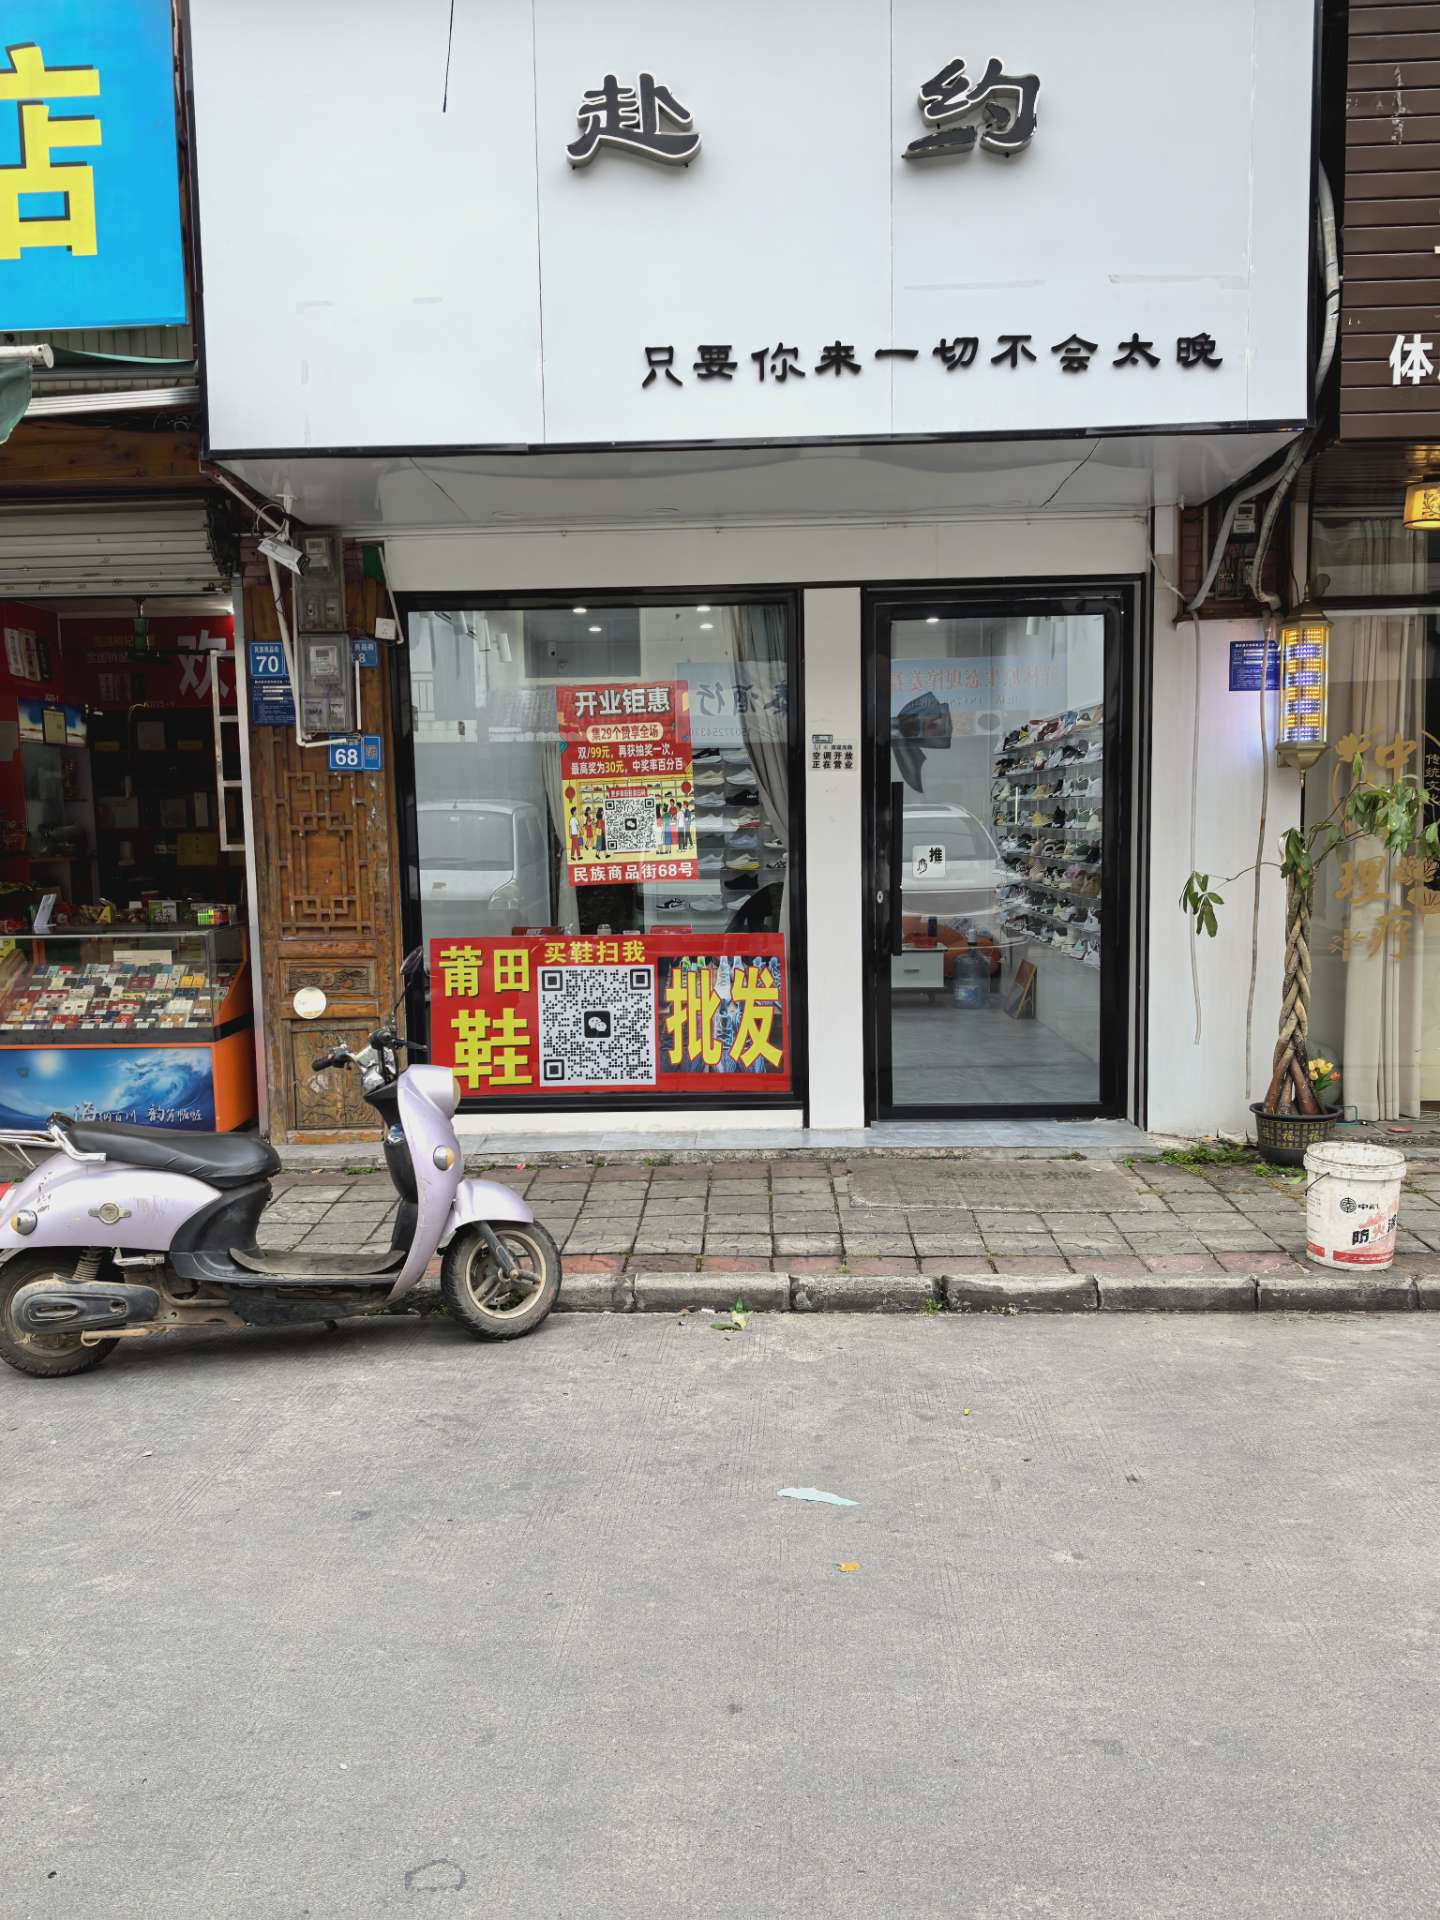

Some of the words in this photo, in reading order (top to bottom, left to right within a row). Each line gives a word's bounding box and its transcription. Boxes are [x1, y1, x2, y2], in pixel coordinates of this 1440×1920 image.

[641, 332, 1224, 388] 只要你来一切不会太晚
[256, 655, 279, 673] 70
[574, 687, 671, 719] 开业钜惠
[335, 748, 359, 765] 68
[928, 847, 943, 864] 推
[573, 861, 694, 882] 民族商品街68号
[544, 940, 646, 964] 买鞋扫我
[439, 945, 530, 998] 莆田
[664, 966, 784, 1068] 批发
[450, 1007, 533, 1090] 鞋
